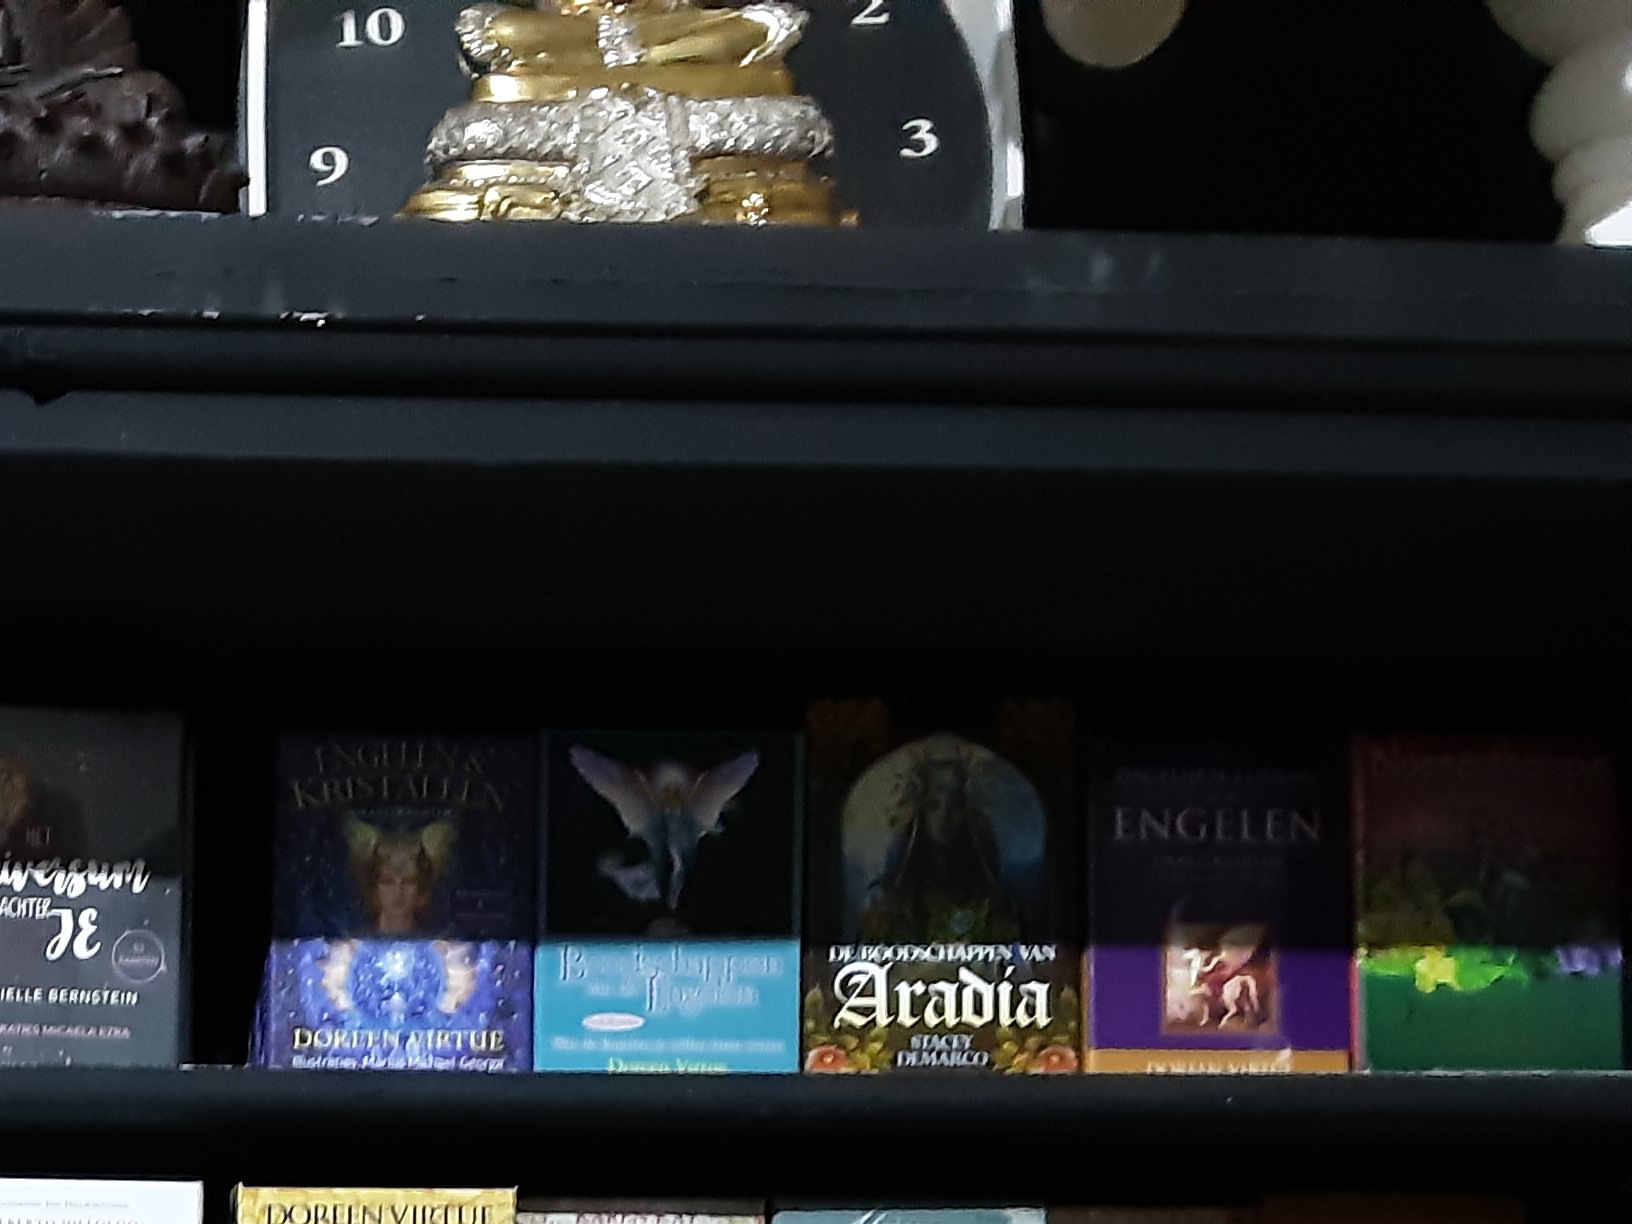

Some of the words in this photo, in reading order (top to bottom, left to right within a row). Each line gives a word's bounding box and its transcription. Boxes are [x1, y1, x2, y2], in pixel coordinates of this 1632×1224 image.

[335, 7, 407, 48] 10
[850, 0, 892, 27] 2
[899, 118, 941, 160] 3
[309, 146, 351, 187] 9
[1114, 806, 1321, 842] ENGELEN
[45, 907, 103, 962] JE
[48, 987, 139, 1007] BERNSTEIN
[292, 1026, 402, 1051] DOREEN
[406, 1027, 505, 1053] VIRTUE
